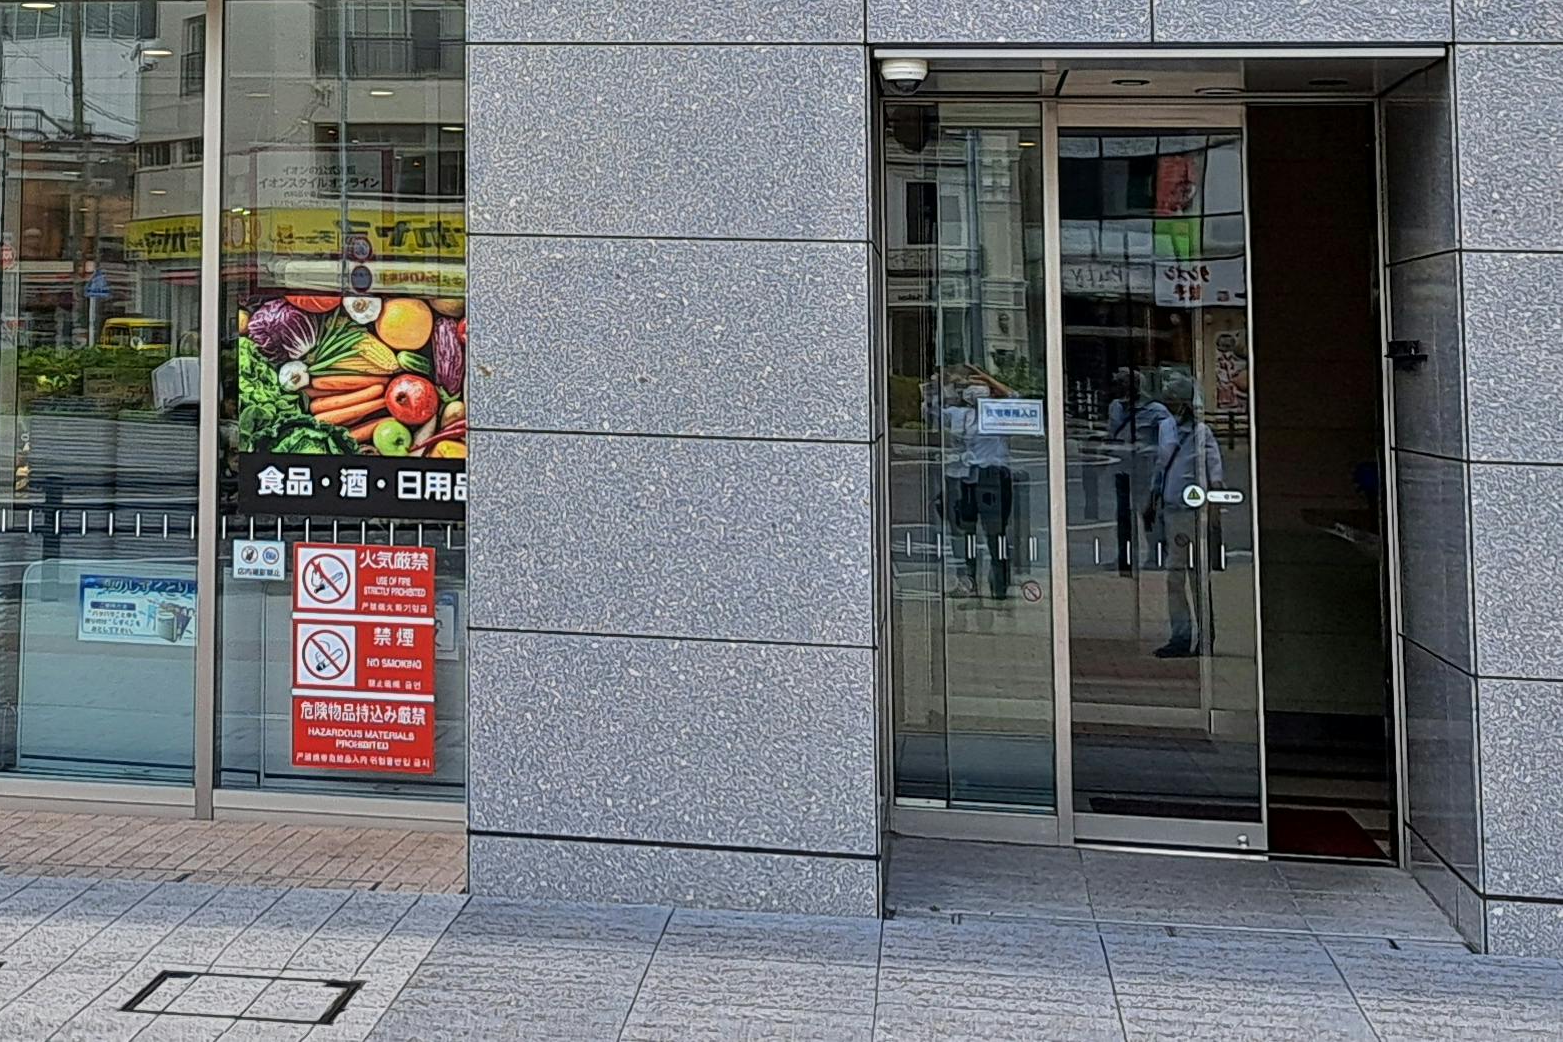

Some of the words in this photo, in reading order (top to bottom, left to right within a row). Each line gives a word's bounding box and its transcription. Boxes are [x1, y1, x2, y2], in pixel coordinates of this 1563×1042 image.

[359, 549, 429, 571] 火気厳禁
[373, 627, 414, 647] 禁煙
[366, 657, 380, 667] NO
[381, 658, 422, 670] SMOKING
[300, 701, 426, 725] 危険物品持込み厳禁
[307, 726, 363, 738] HAZARDOUS
[364, 729, 415, 741] MATERIALS
[335, 739, 389, 750] PROHIBITED
